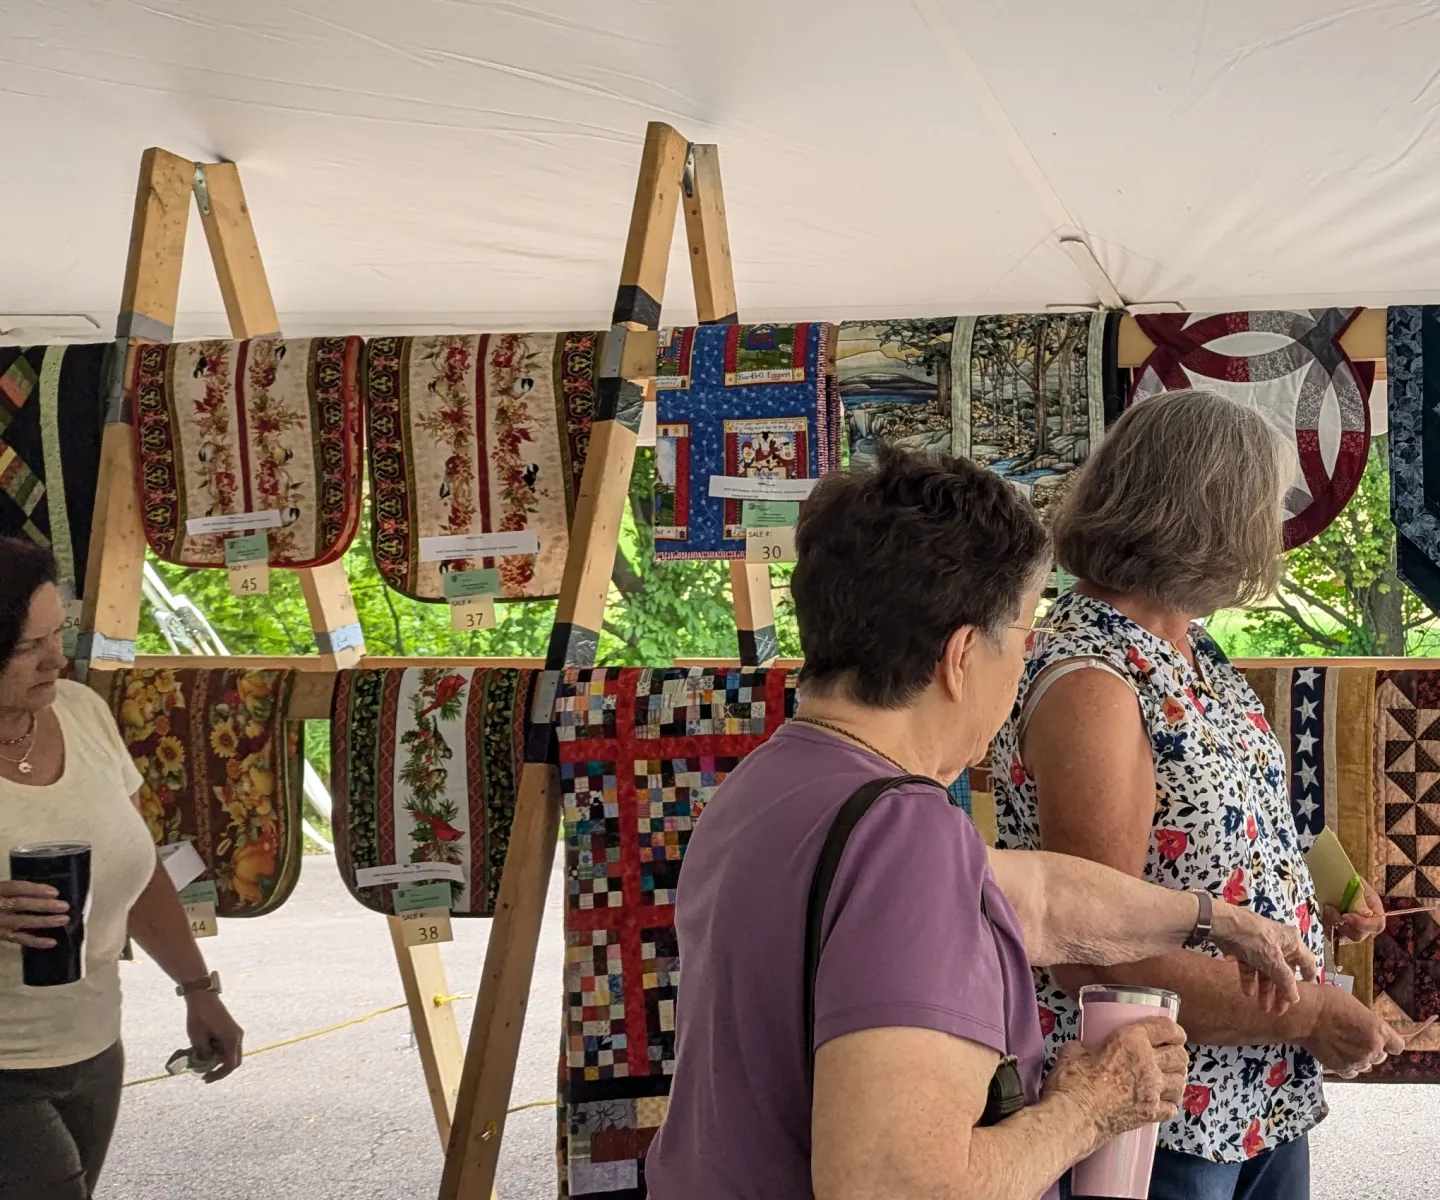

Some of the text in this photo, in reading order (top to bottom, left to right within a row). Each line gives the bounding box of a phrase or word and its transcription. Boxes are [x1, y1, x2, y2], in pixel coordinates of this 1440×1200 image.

[748, 530, 763, 538] SALE
[762, 545, 782, 560] 30
[241, 577, 257, 592] 45
[466, 612, 484, 627] 37
[418, 926, 439, 941] 38
